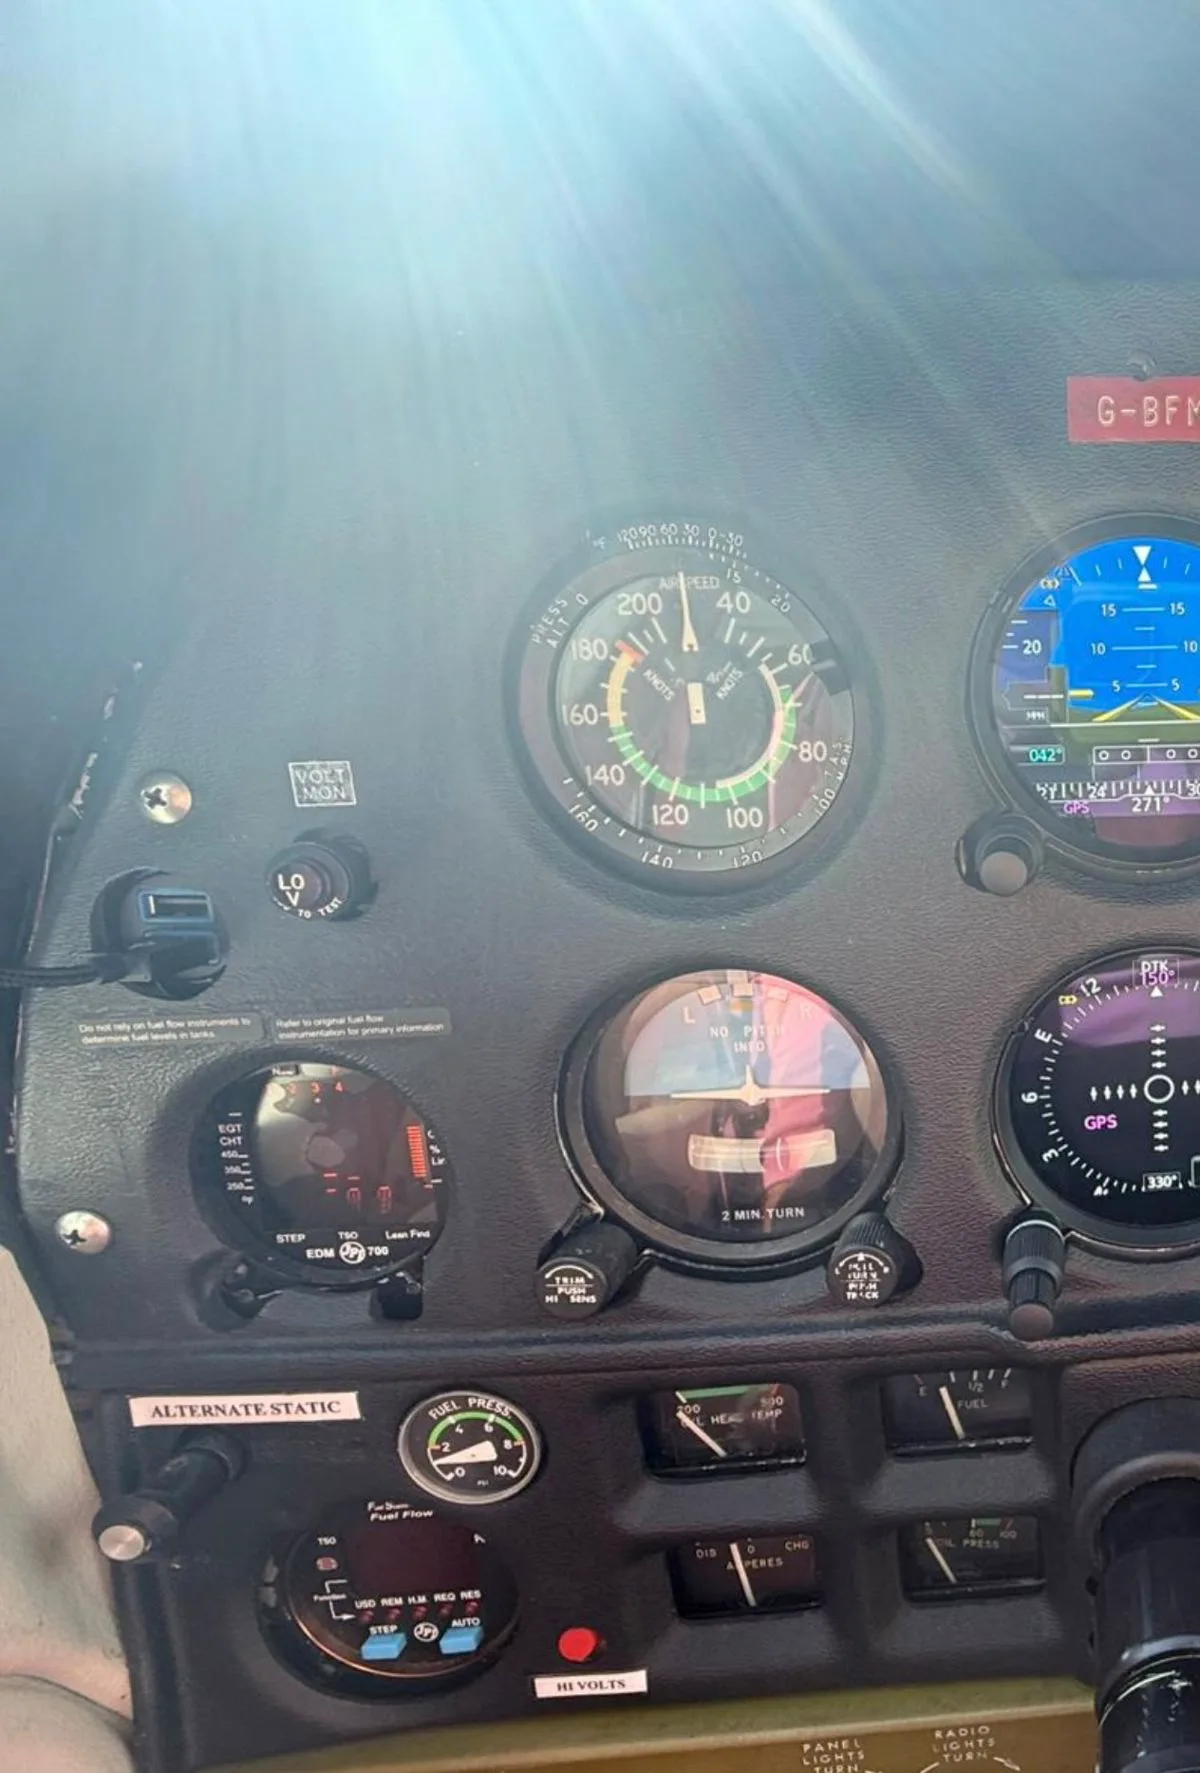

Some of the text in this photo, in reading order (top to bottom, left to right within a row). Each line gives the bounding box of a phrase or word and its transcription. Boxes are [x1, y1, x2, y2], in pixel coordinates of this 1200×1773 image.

[617, 592, 662, 615] 200
[716, 593, 751, 613] 40
[1101, 603, 1185, 616] 15 15
[571, 638, 608, 661] 180
[1023, 640, 1042, 654] 20
[1091, 641, 1199, 655] 10 10
[644, 669, 674, 701] KNOTS
[716, 669, 744, 700] KNOTS
[1112, 679, 1180, 692] 5 5
[562, 704, 598, 725] 160
[799, 741, 827, 761] 80
[296, 768, 344, 785] VOLT
[586, 764, 624, 786] 140
[302, 785, 347, 800] MON
[652, 804, 689, 826] 120
[1064, 802, 1090, 814] GPS
[726, 808, 763, 828] 100
[278, 874, 305, 890] LO
[1080, 979, 1102, 995] 12
[302, 1018, 311, 1026] to
[313, 1017, 346, 1027] original
[348, 1015, 364, 1024] fuel
[366, 1014, 383, 1022] flow
[684, 1007, 695, 1024] L
[278, 1029, 345, 1039] instrumentation
[362, 1026, 394, 1035] primary
[396, 1023, 444, 1033] information
[1036, 1029, 1052, 1042] E
[218, 1124, 242, 1133] EGT
[1084, 1115, 1118, 1129] GPS
[220, 1137, 242, 1146] CHT
[276, 1233, 306, 1243] STEP
[338, 1231, 359, 1240] TSO
[385, 1229, 408, 1240] Lean
[555, 1276, 585, 1284] TRIM
[151, 1400, 342, 1419] ALTERNATE STATIC
[428, 1400, 461, 1421] FUEL
[957, 1399, 988, 1410] FUEL
[456, 1422, 494, 1434] 4 6
[442, 1439, 512, 1452] 2 8
[455, 1465, 508, 1478] 0 10
[402, 1510, 433, 1518] Flow
[317, 1537, 336, 1545] TSO
[355, 1590, 481, 1609] USD REM REQ RES
[369, 1618, 480, 1634] STEP AUTO
[556, 1679, 627, 1692] HI VOLTS
[935, 1726, 990, 1739] RADIO
[802, 1739, 863, 1751] PANEL
[932, 1738, 996, 1753] LIGHTS
[802, 1750, 864, 1765] LIGHTS
[943, 1751, 988, 1762] TURN
